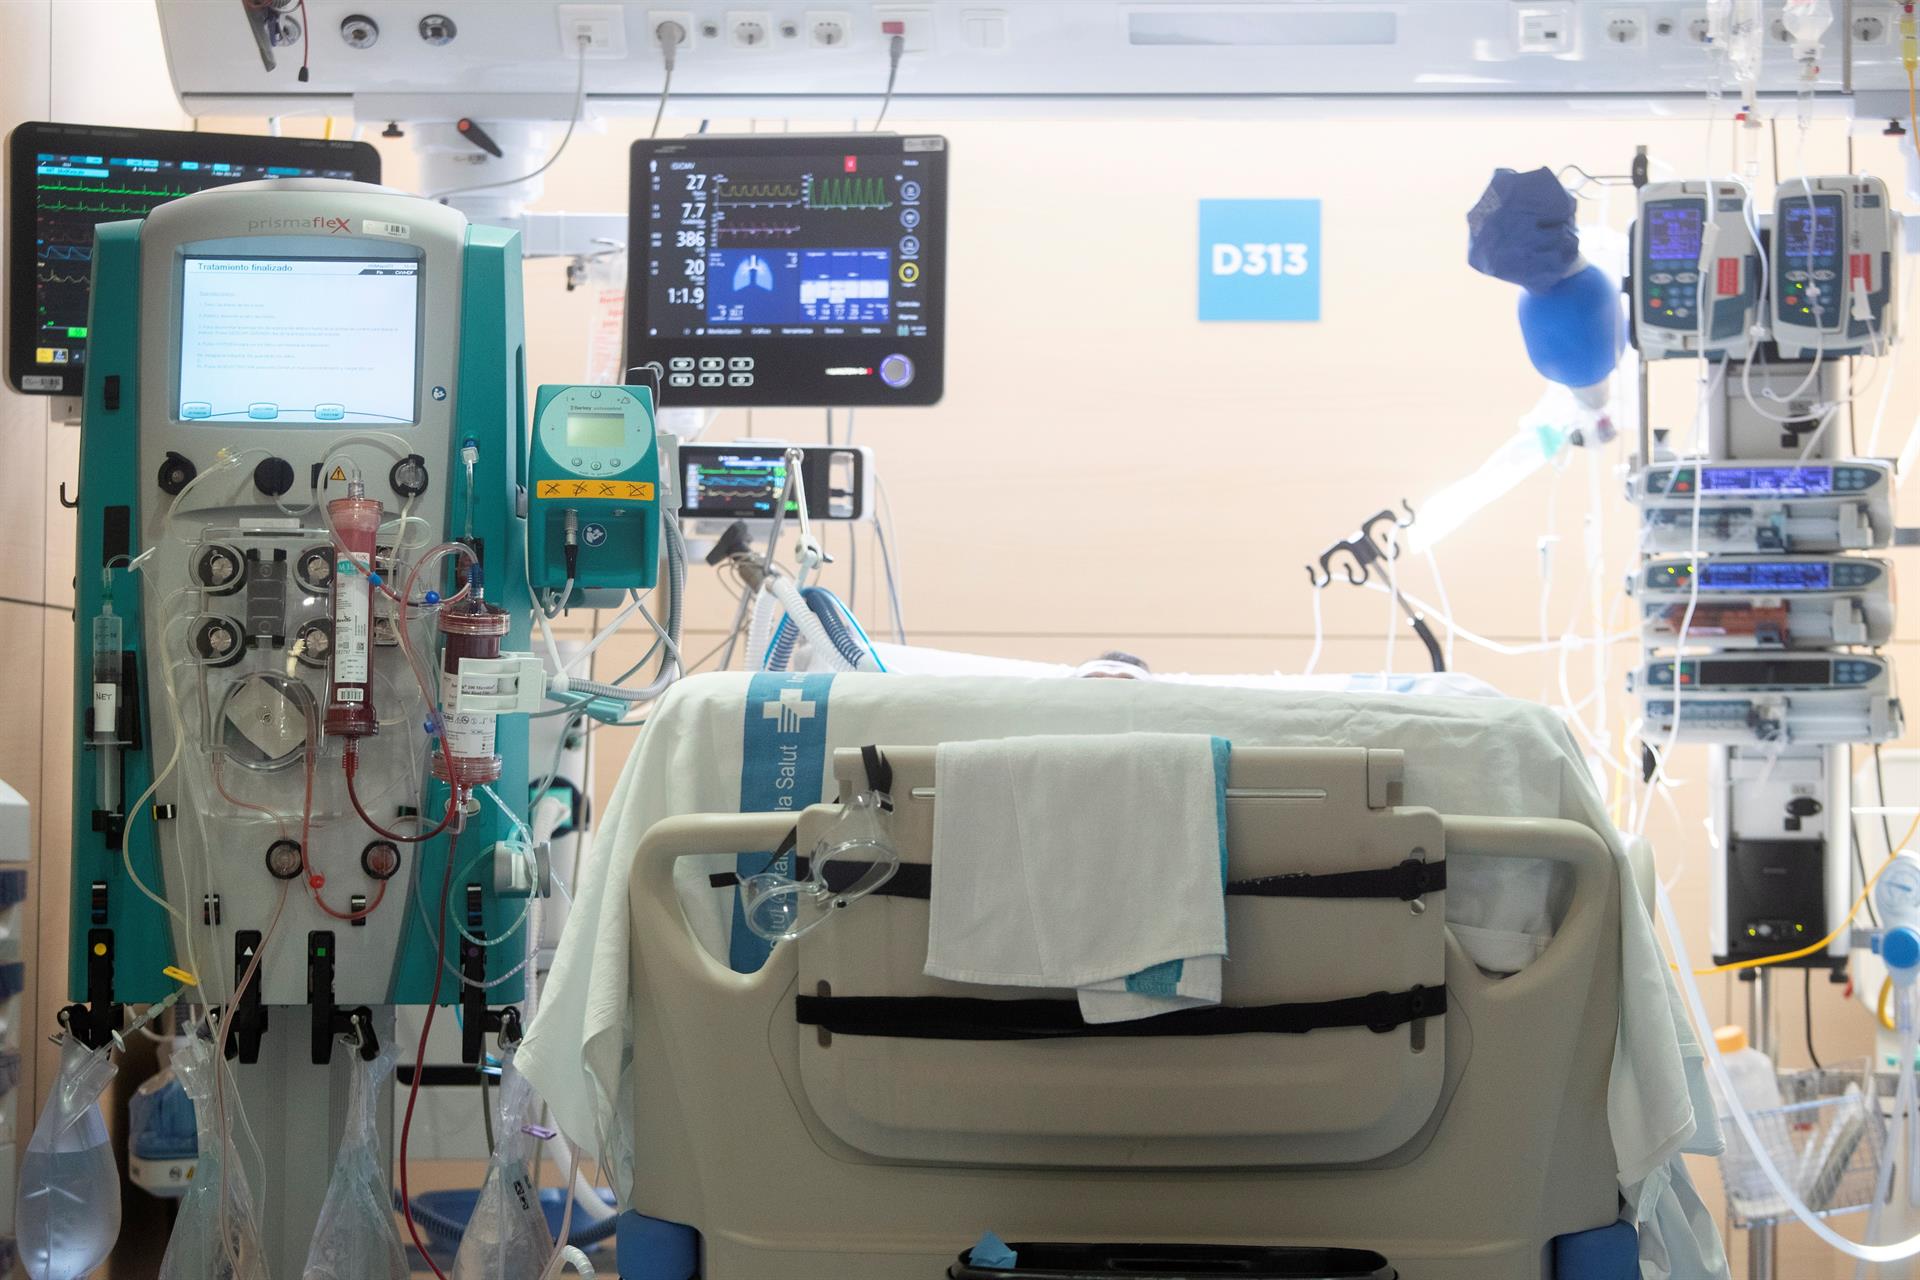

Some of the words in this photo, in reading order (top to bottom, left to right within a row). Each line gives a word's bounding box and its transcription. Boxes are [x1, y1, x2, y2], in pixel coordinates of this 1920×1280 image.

[686, 174, 706, 190] 27
[682, 203, 706, 218] 7.7
[248, 216, 352, 234] prismaflex
[676, 231, 705, 247] 386
[1211, 242, 1308, 275] D313
[198, 263, 249, 271] Tratamiento
[251, 263, 293, 271] finalizado
[685, 259, 705, 275] 20
[668, 287, 704, 304] 1:1.9
[775, 745, 798, 789] Salut
[774, 796, 793, 811] la
